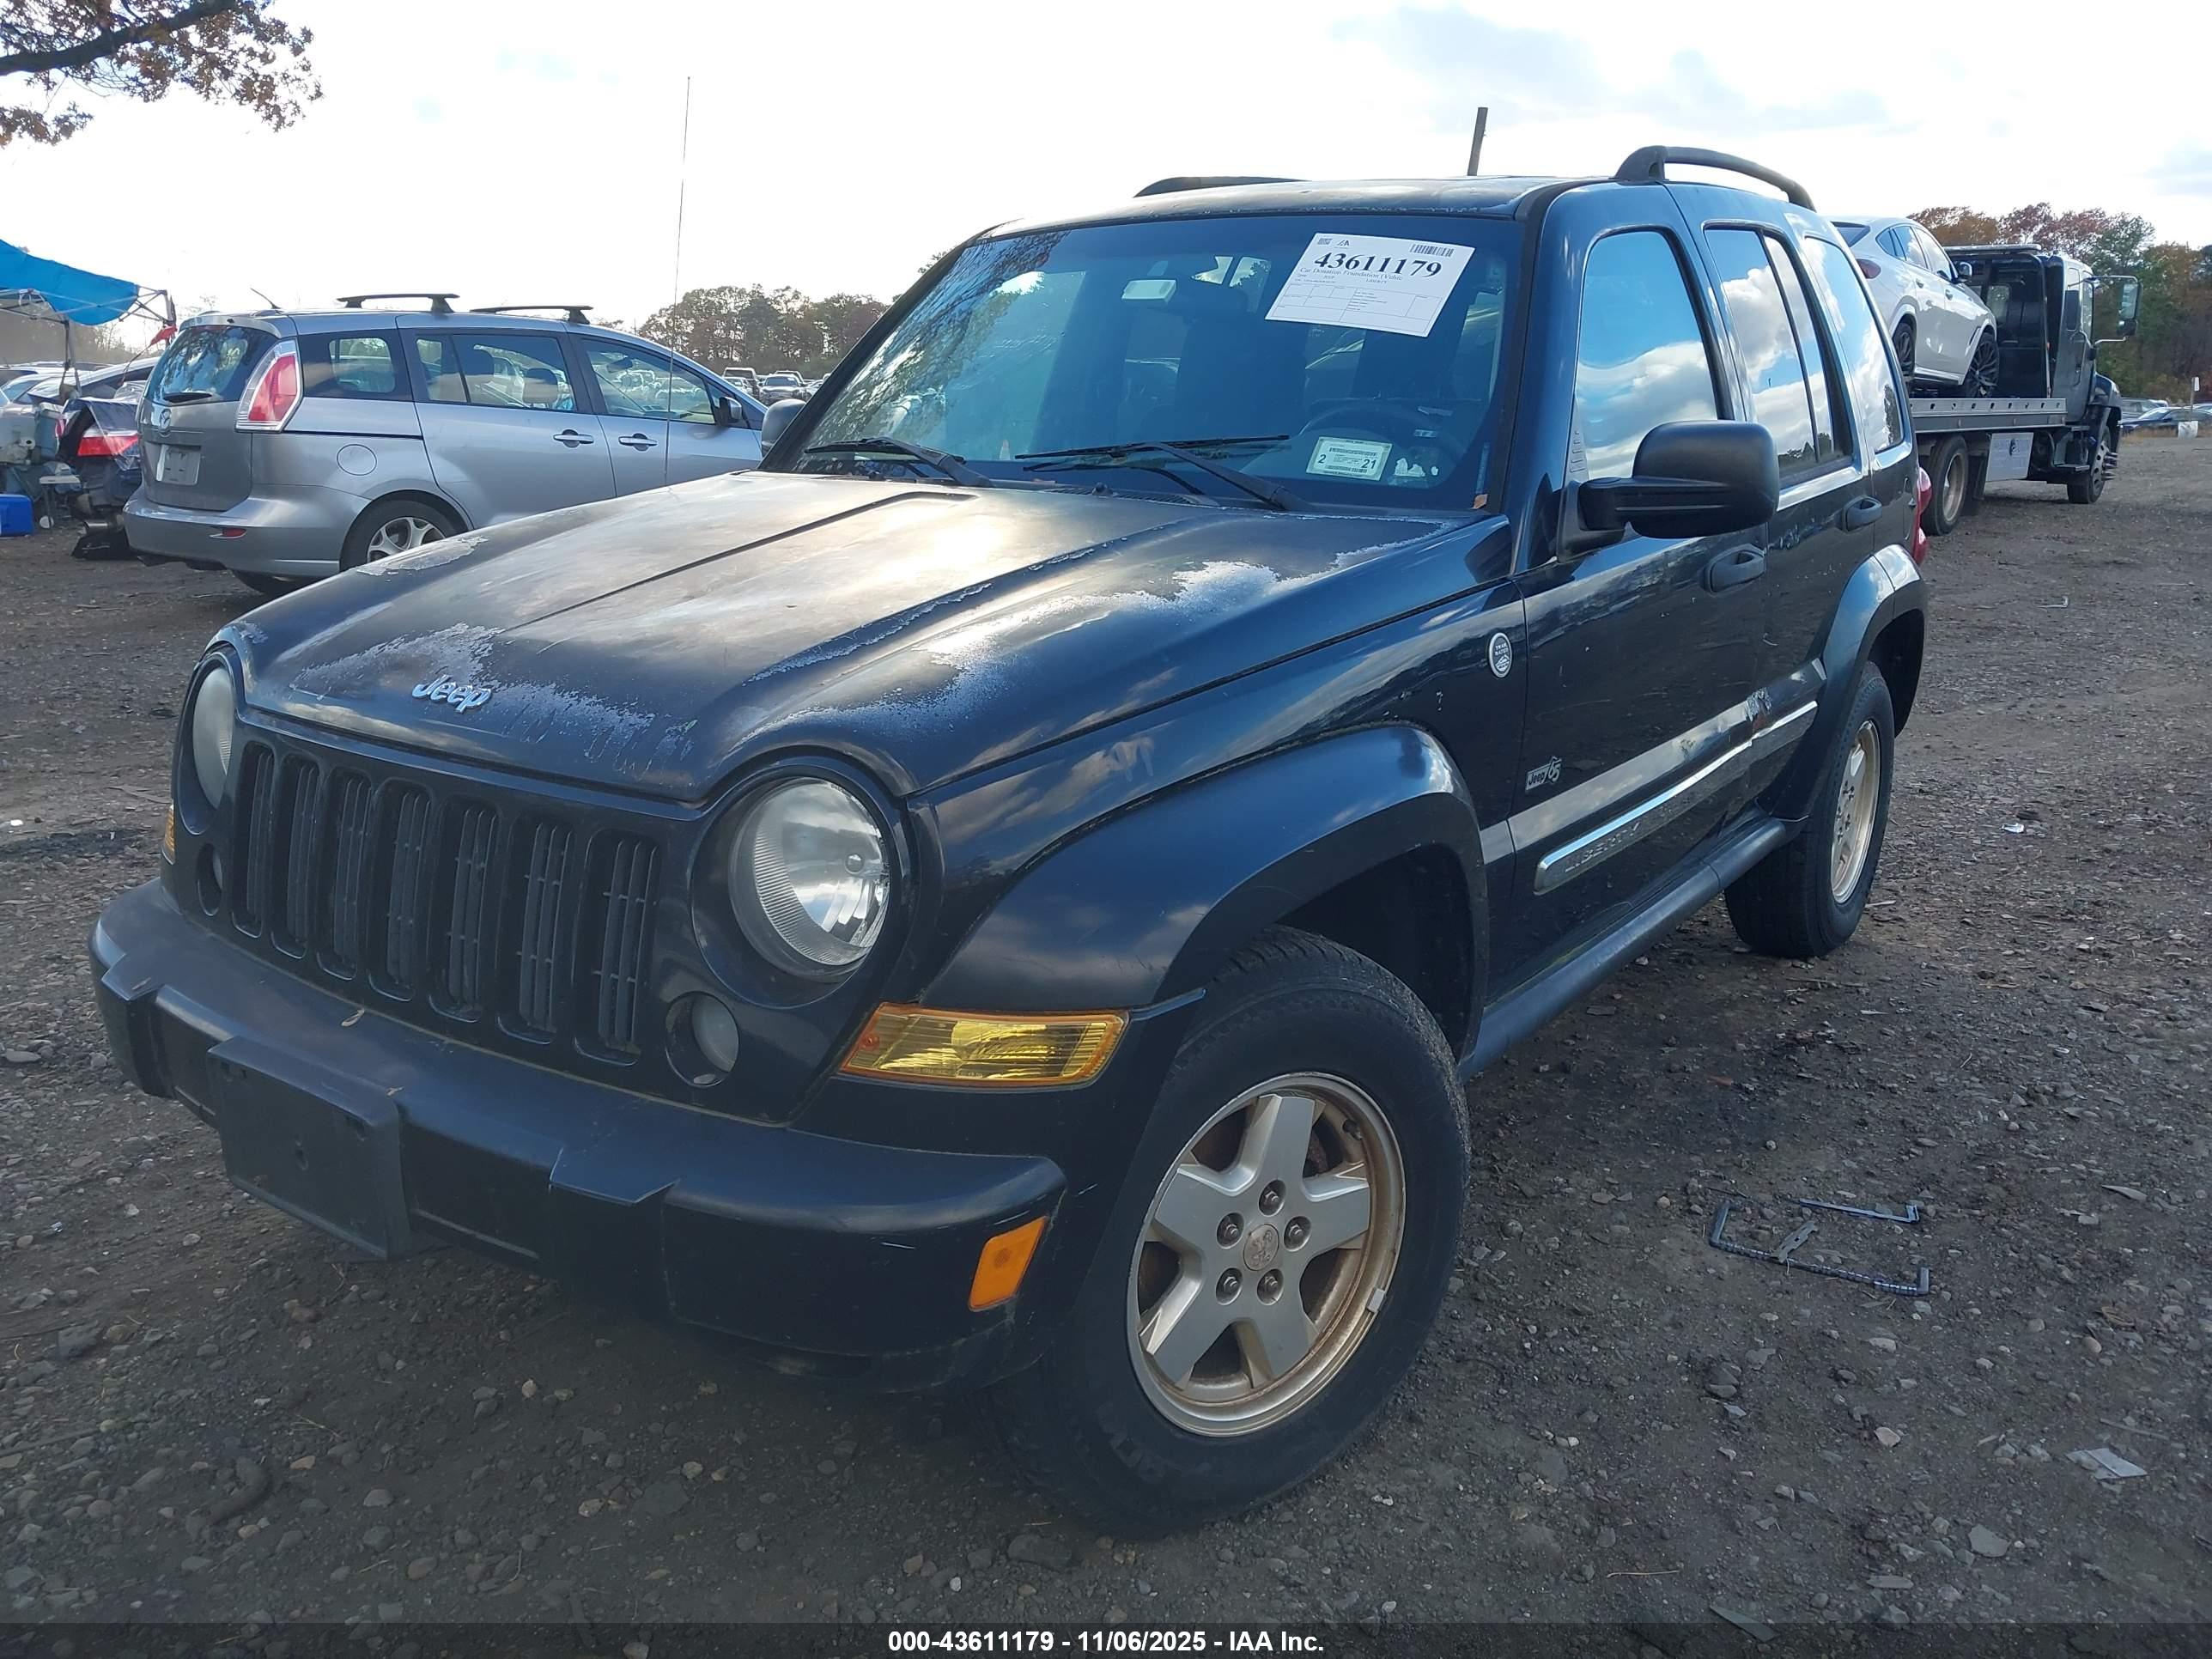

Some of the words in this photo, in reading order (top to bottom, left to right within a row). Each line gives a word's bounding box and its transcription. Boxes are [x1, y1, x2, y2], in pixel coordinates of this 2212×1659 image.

[1314, 252, 1443, 278] 43611179
[1318, 453, 1327, 464] 2
[1361, 459, 1376, 470] 21
[412, 674, 492, 714] Jeep
[1528, 771, 1546, 786] Jeep
